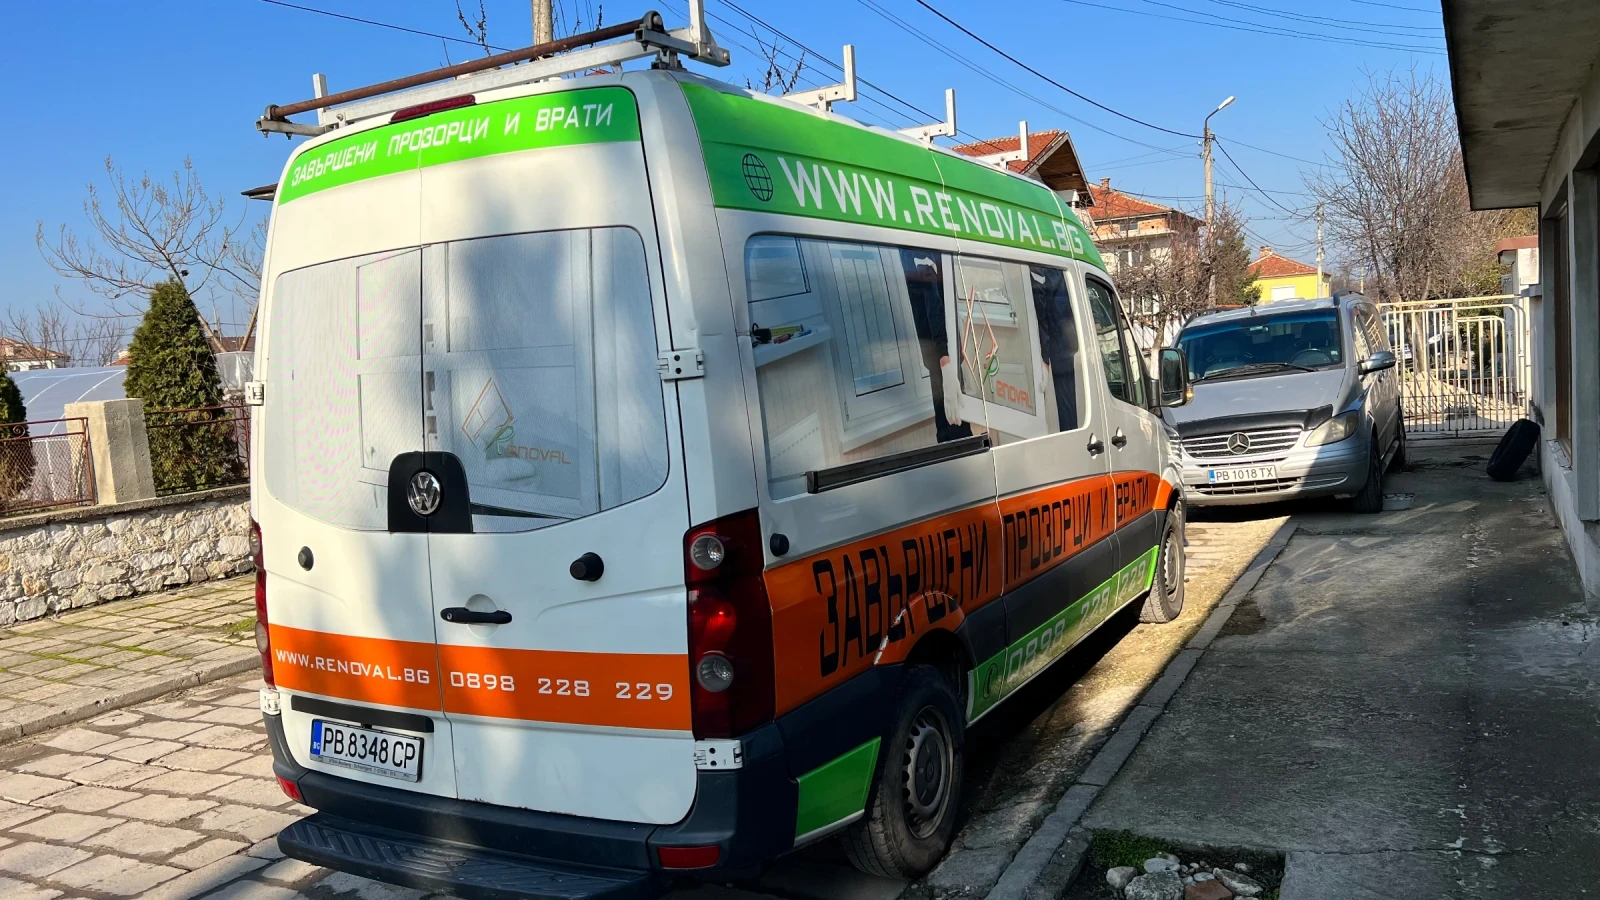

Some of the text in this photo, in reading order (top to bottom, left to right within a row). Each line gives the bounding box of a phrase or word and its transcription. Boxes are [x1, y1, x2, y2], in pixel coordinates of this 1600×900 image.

[291, 102, 614, 186] ЗАВЪРШЕНИ ПРОЗОРЦИ И ВРАТИ
[777, 156, 1084, 255] WWW.RENOVAL.BG
[1232, 468, 1258, 480] 1018
[812, 477, 1150, 678] ЗАВЪРШЕНИ ПРОЗОРЦИ И ВРАТИ
[1007, 560, 1146, 683] 0898 228 229
[275, 649, 431, 685] WWW.RENOVAL.BG
[450, 670, 674, 701] 0898 228 229
